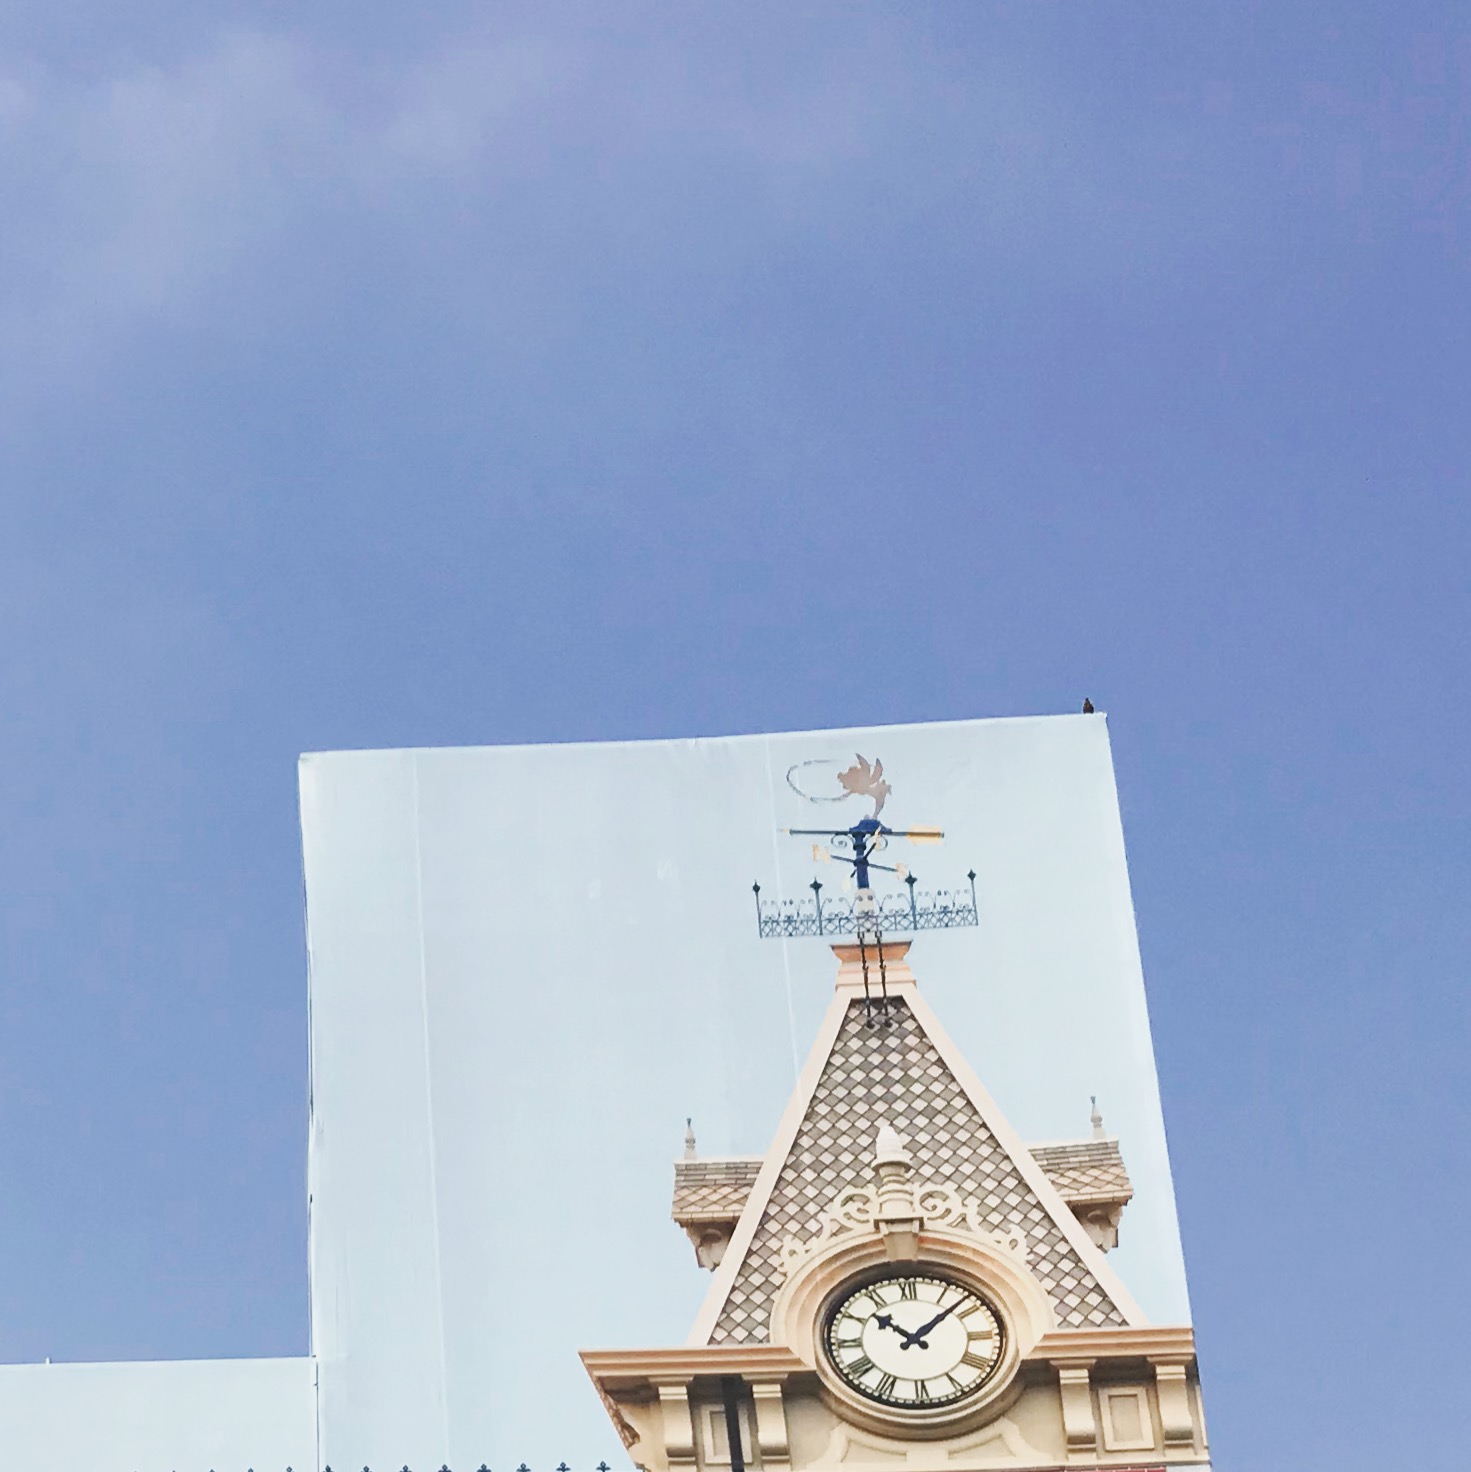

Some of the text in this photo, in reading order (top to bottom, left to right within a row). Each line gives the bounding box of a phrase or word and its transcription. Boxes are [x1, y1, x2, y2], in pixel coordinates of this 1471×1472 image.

[864, 1288, 888, 1310] XI
[897, 1282, 917, 1300] XII
[955, 1303, 980, 1320] II
[837, 1337, 863, 1349] IX
[966, 1330, 994, 1341] III
[914, 1379, 930, 1399] VI
